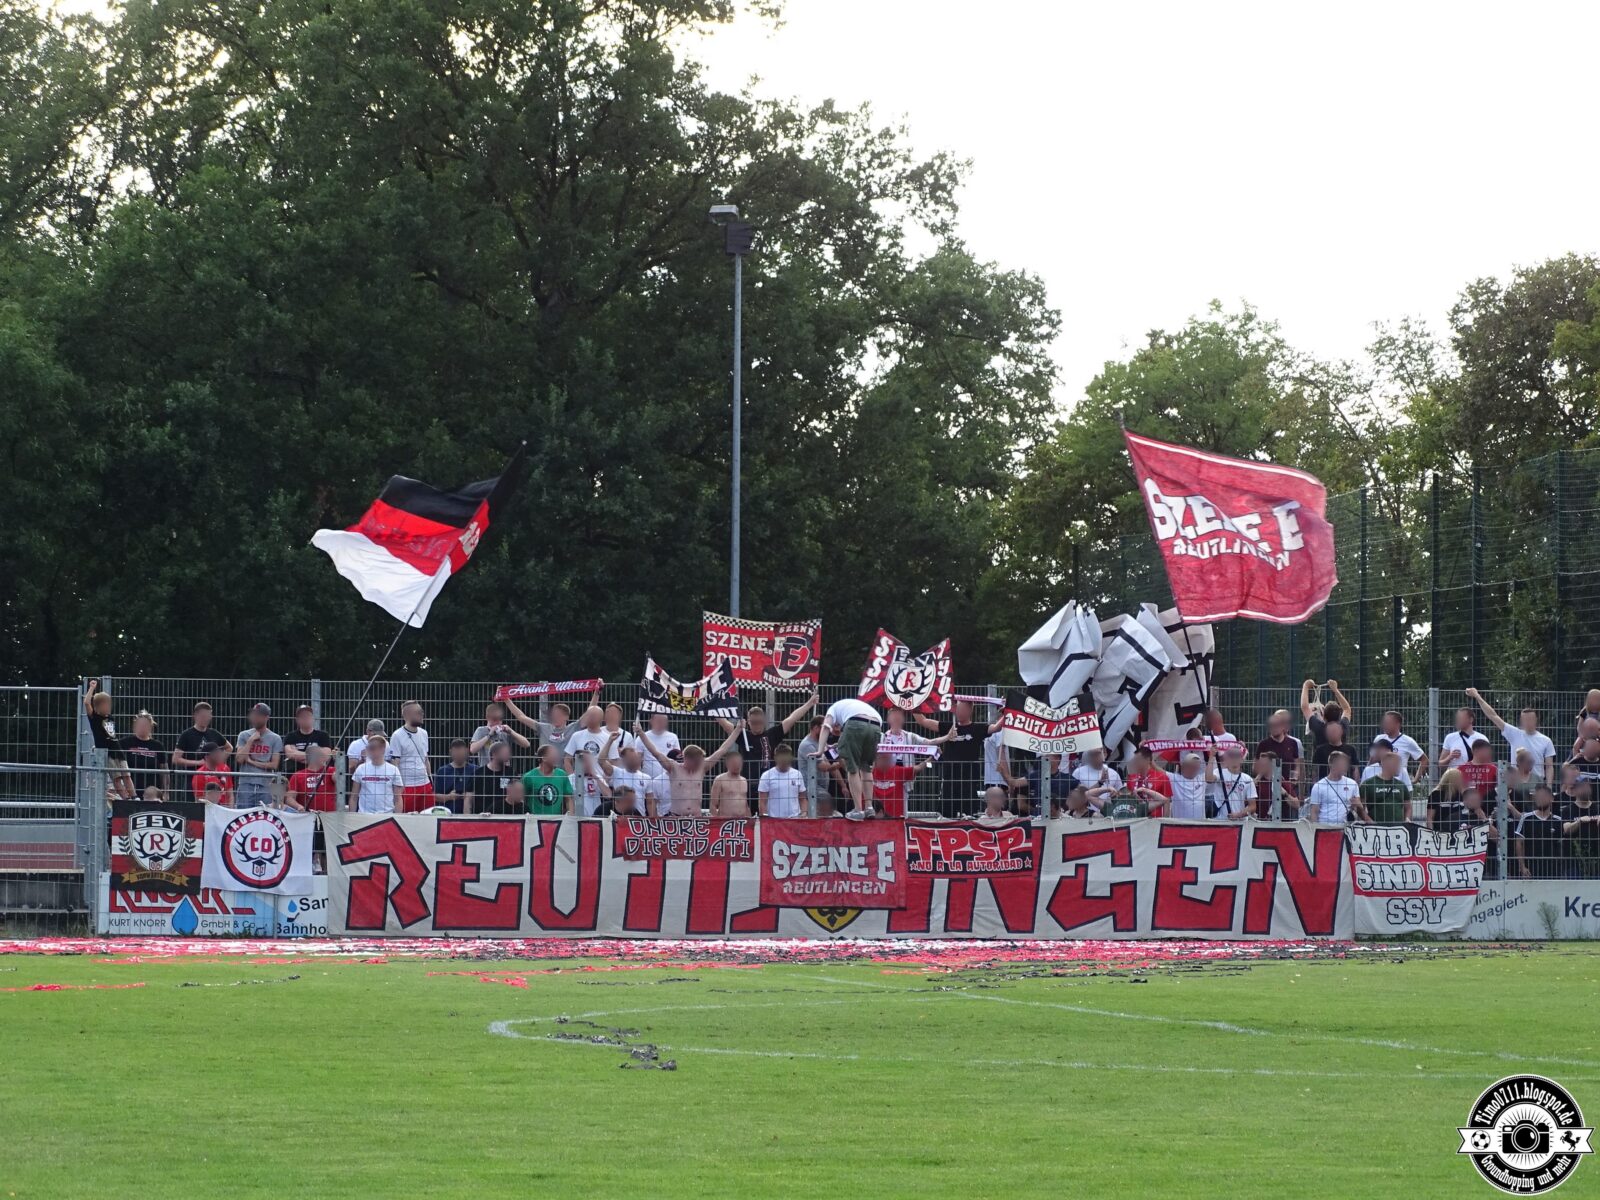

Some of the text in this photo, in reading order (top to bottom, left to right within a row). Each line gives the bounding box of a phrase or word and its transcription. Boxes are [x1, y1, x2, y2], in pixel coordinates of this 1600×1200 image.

[1273, 501, 1304, 551] E
[705, 630, 768, 652] SZENE
[705, 651, 752, 670] 2005
[508, 684, 549, 696] Avanti
[554, 680, 590, 691] Ultras
[763, 671, 811, 687] REUTLINGEN
[1024, 696, 1081, 722] SZENE
[1004, 712, 1099, 736] REUTLINGEN
[1028, 737, 1077, 754] 2005
[136, 816, 180, 829] SSV
[719, 819, 748, 838] AI
[149, 833, 164, 851] R
[625, 837, 750, 857] DIFFIDATI
[908, 826, 1026, 863] TPSP
[1348, 824, 1488, 857] WIR ALLE
[772, 840, 896, 882] SZENE E
[916, 858, 1024, 872] NO A LA AUTORIDAD
[1355, 862, 1484, 891] SIND DER
[783, 880, 887, 895] REUTLINGEN
[1387, 897, 1447, 924] SSV
[109, 918, 167, 928] KURT KNORR
[201, 920, 230, 929] GmbH
